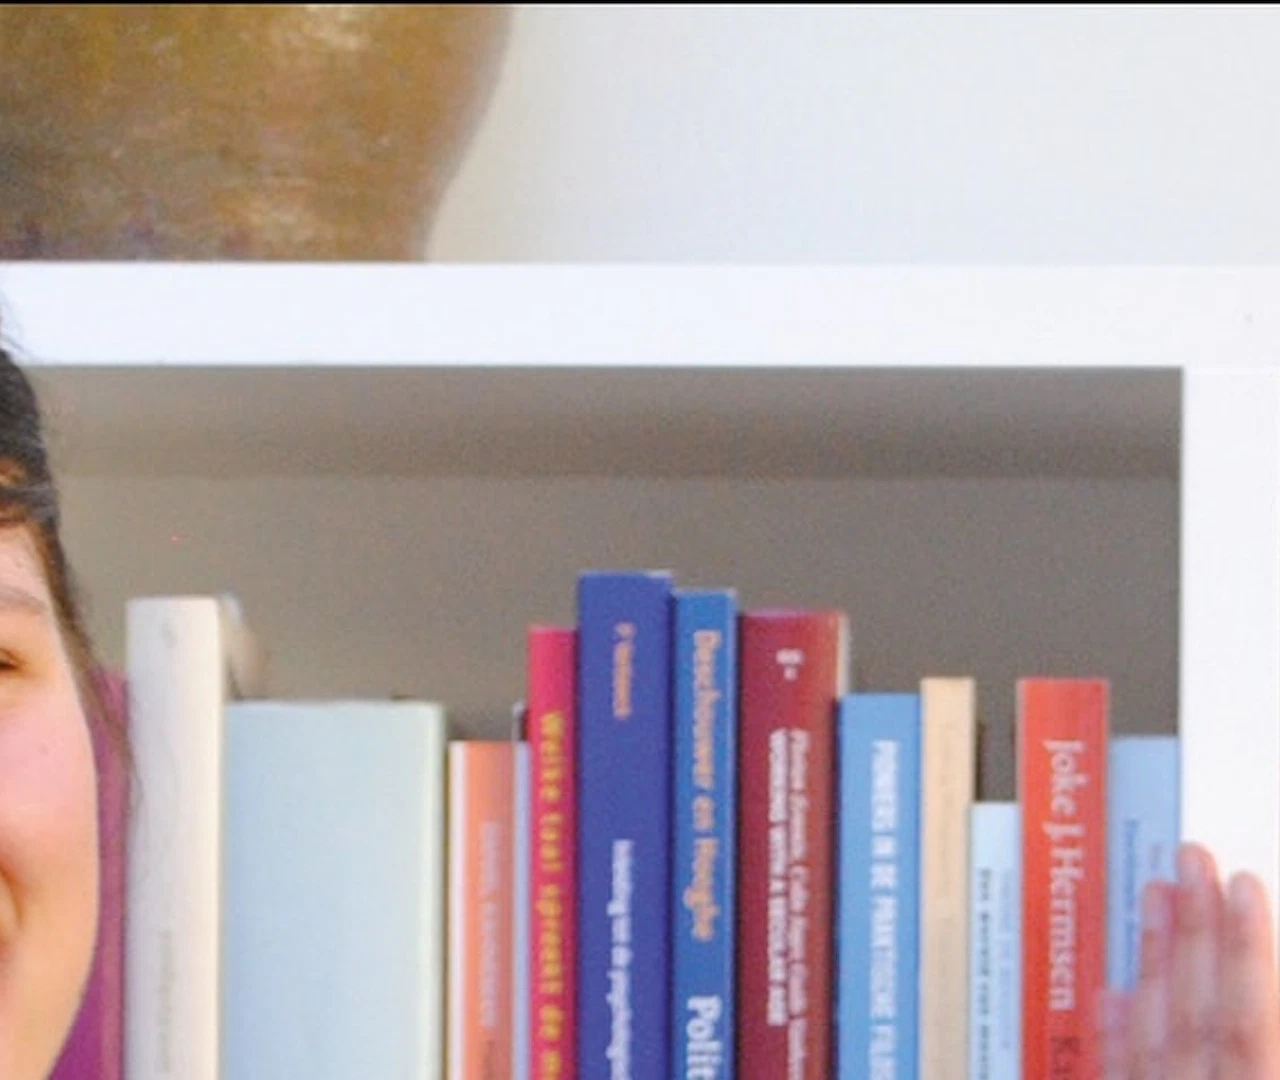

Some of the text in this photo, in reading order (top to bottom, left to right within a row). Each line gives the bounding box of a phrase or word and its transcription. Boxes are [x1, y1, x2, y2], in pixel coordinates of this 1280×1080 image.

[1043, 737, 1086, 817] Joke
[539, 811, 564, 873] taal
[693, 796, 718, 833] en
[534, 883, 563, 995] spreekt
[1050, 845, 1085, 1012] Hermsen
[538, 1003, 563, 1041] de
